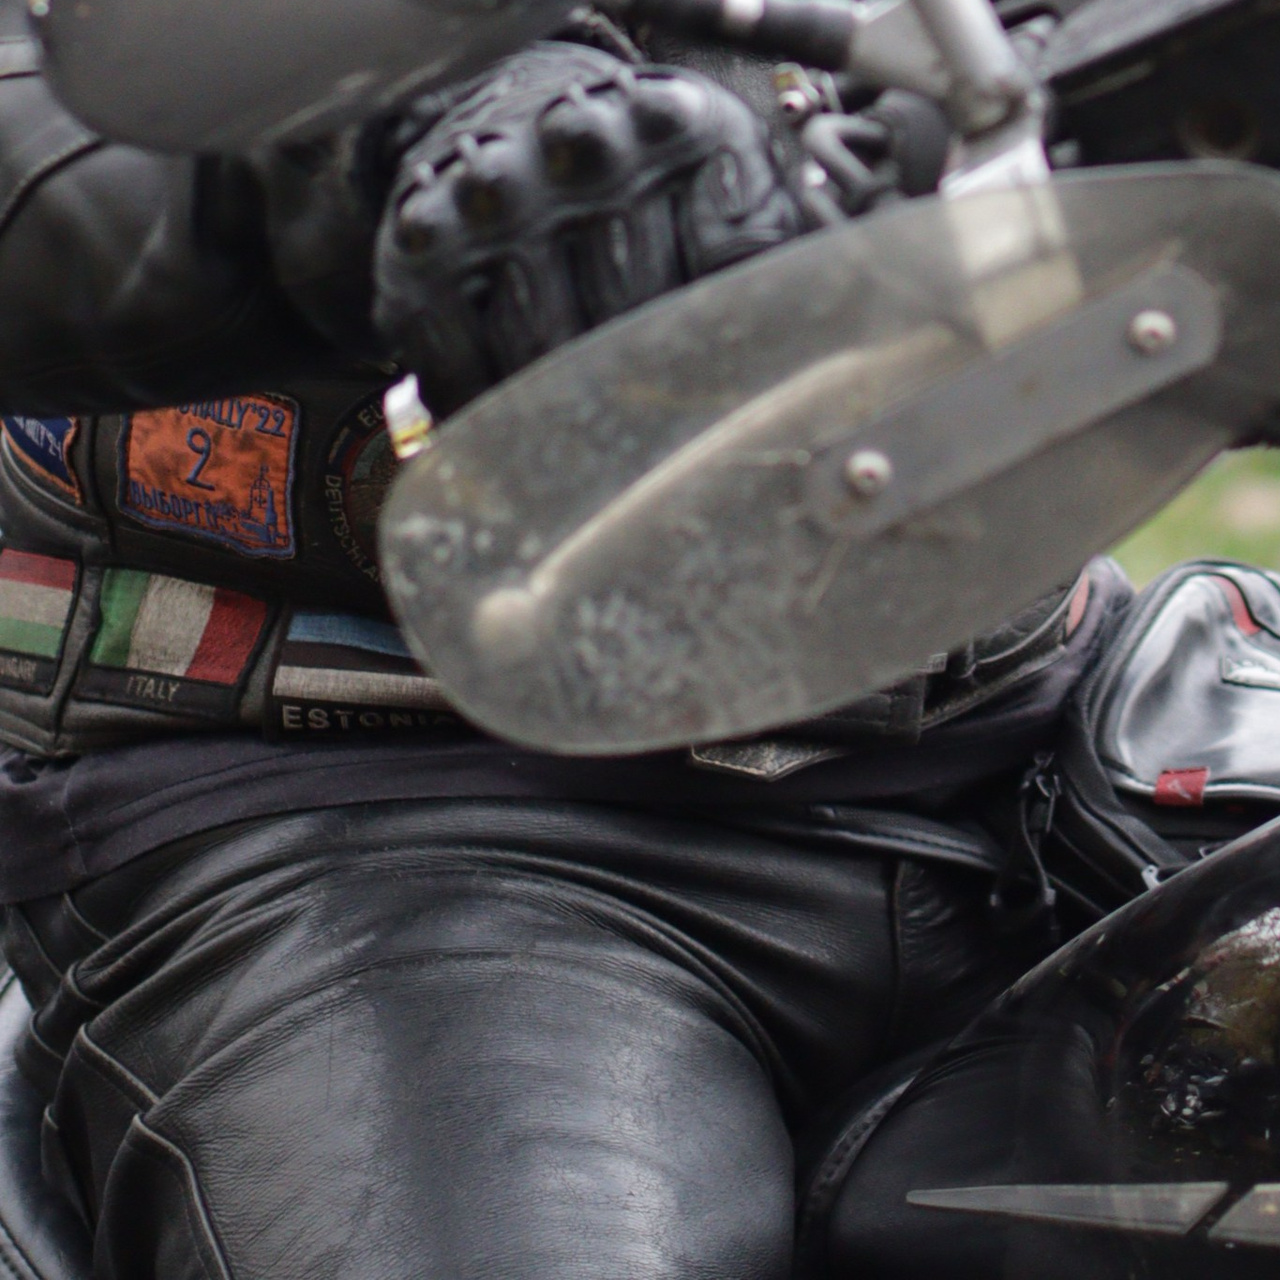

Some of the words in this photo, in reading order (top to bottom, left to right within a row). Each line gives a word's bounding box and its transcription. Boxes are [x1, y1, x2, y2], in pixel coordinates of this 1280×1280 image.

[185, 426, 216, 492] 2
[324, 474, 380, 582] DEUTSCHLA
[126, 676, 180, 702] ITALY
